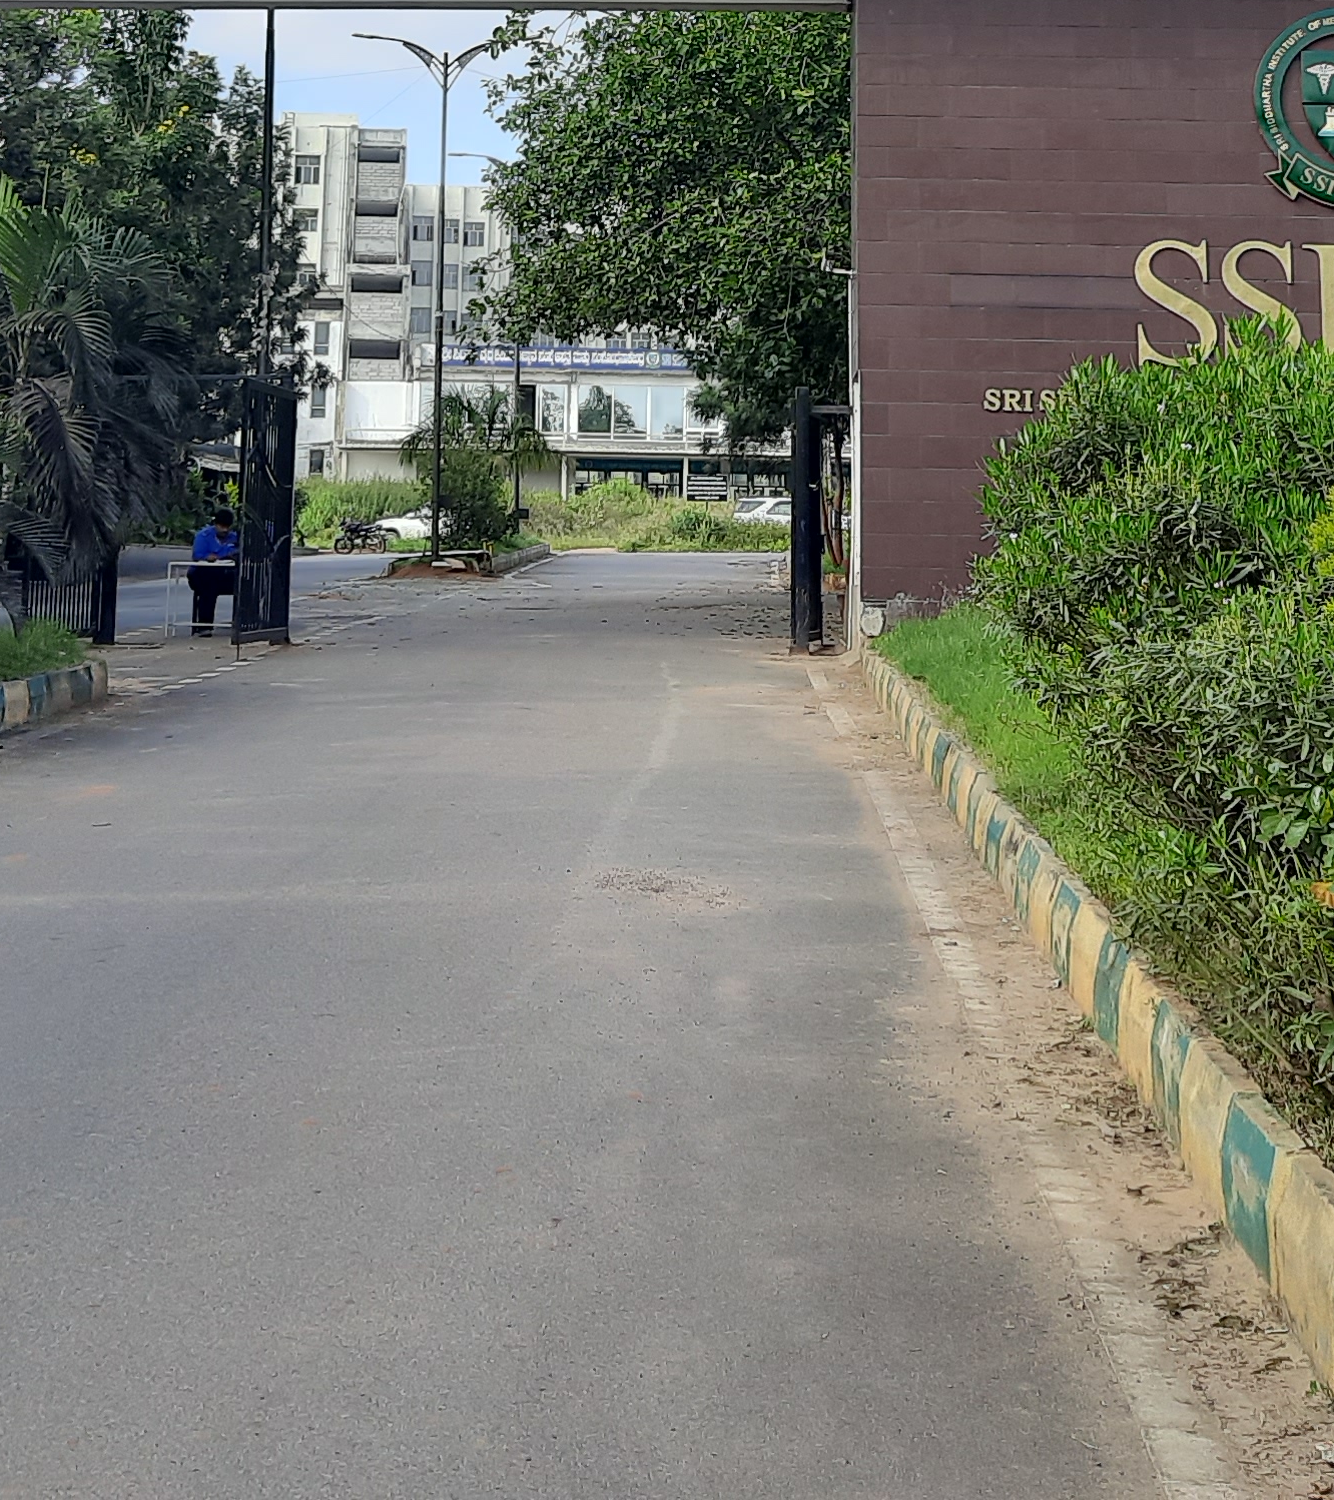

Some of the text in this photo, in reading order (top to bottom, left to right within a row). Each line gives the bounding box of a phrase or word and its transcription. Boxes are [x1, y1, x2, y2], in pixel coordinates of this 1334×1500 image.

[1307, 19, 1323, 31] OF
[1268, 28, 1306, 71] INSTITUTE
[1272, 133, 1289, 151] SRI
[982, 388, 1035, 413] SRI
